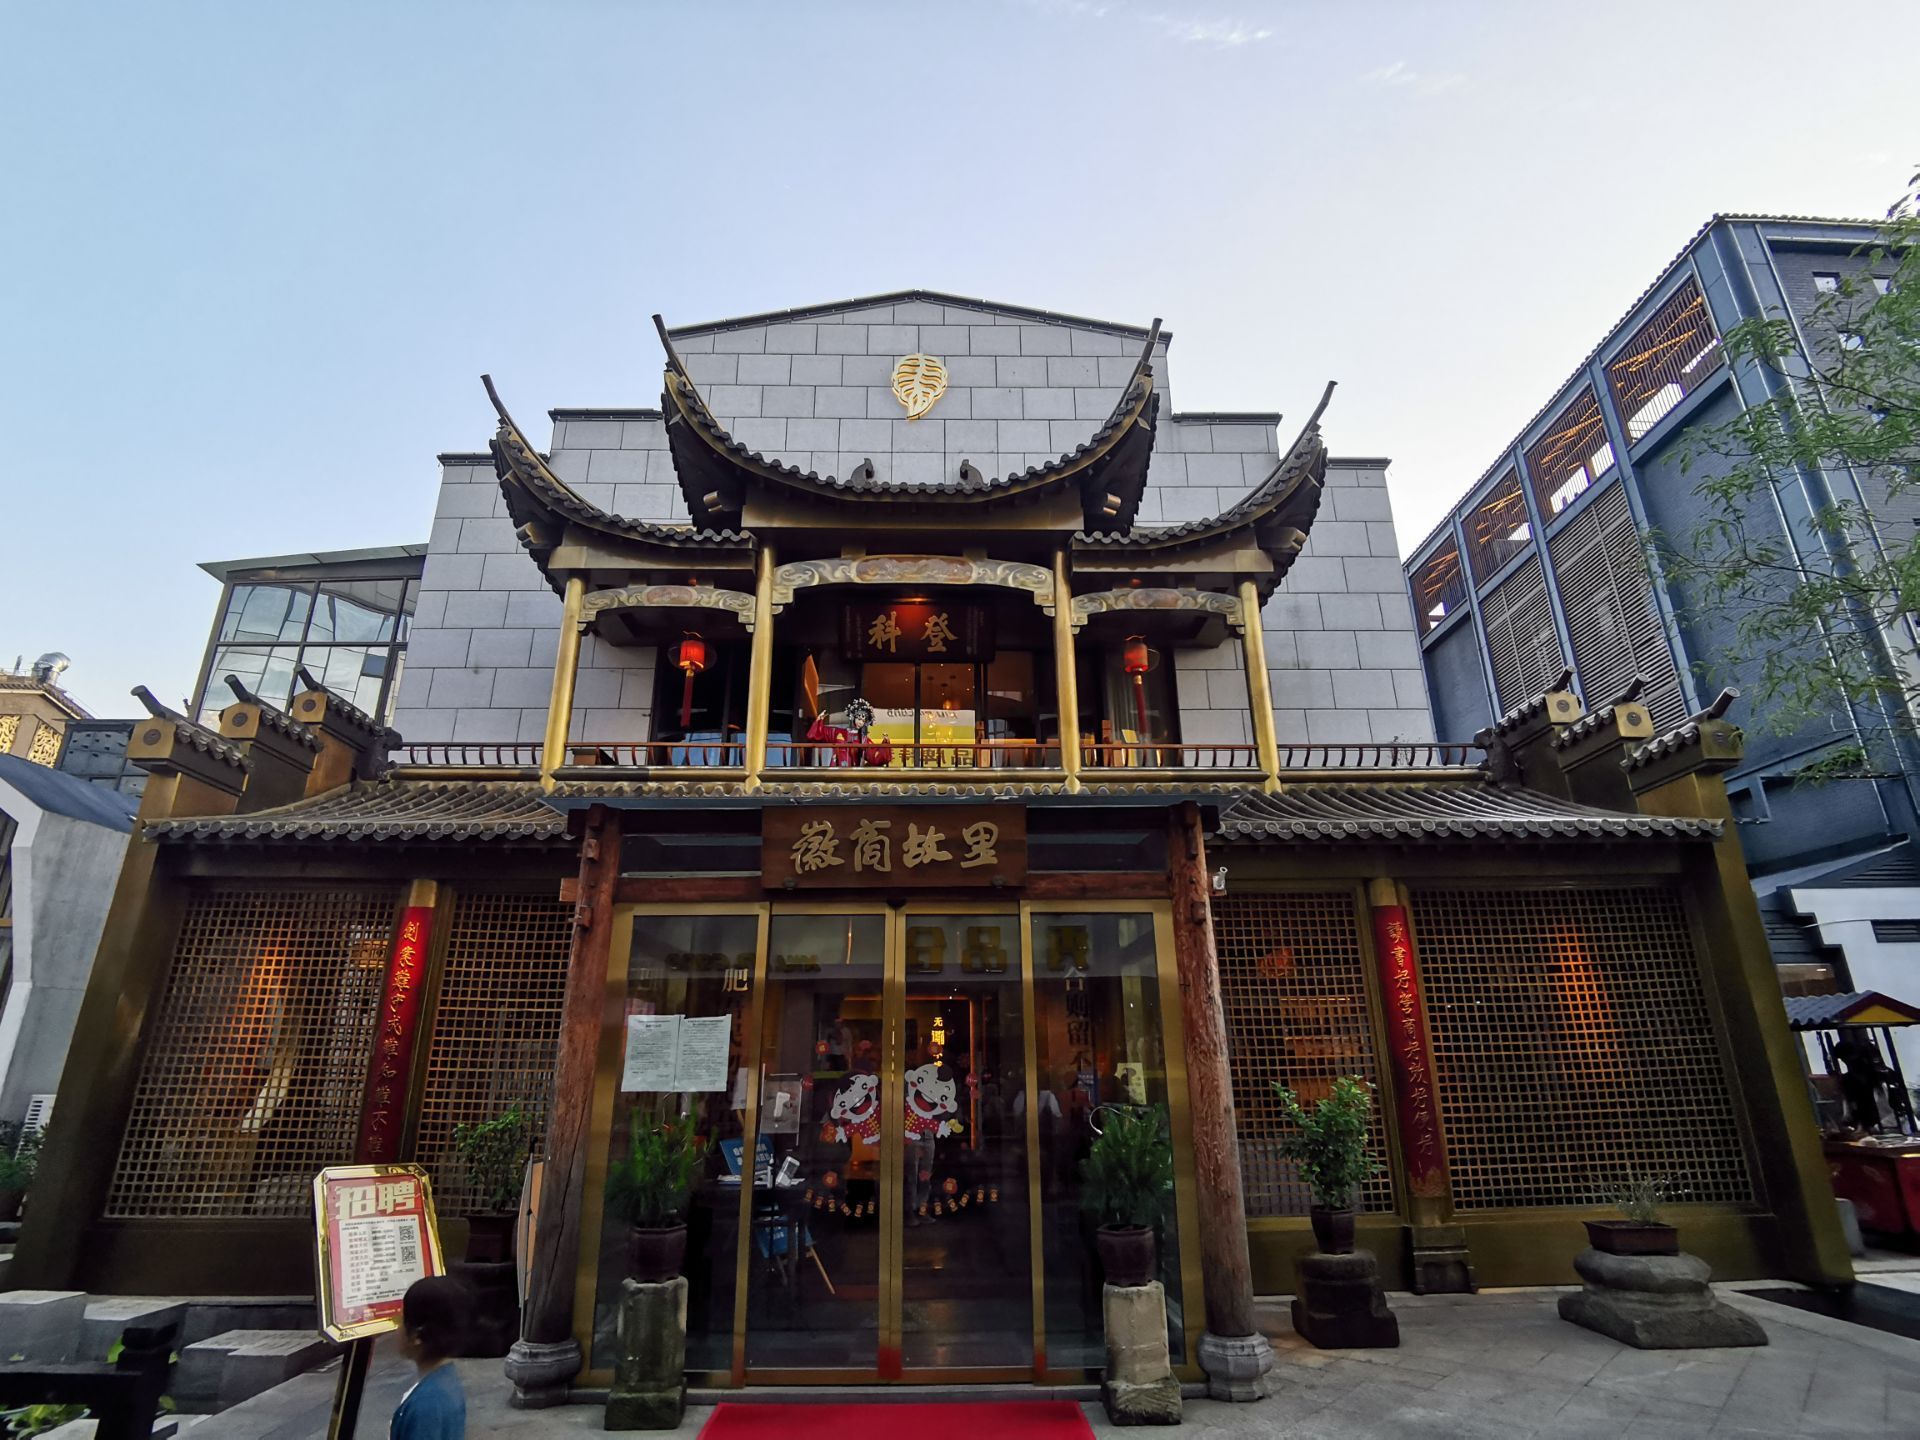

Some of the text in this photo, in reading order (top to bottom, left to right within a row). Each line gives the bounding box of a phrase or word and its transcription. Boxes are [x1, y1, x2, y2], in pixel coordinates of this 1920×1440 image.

[789, 818, 1000, 875] 徽商故里
[335, 1181, 416, 1220] 招聘
